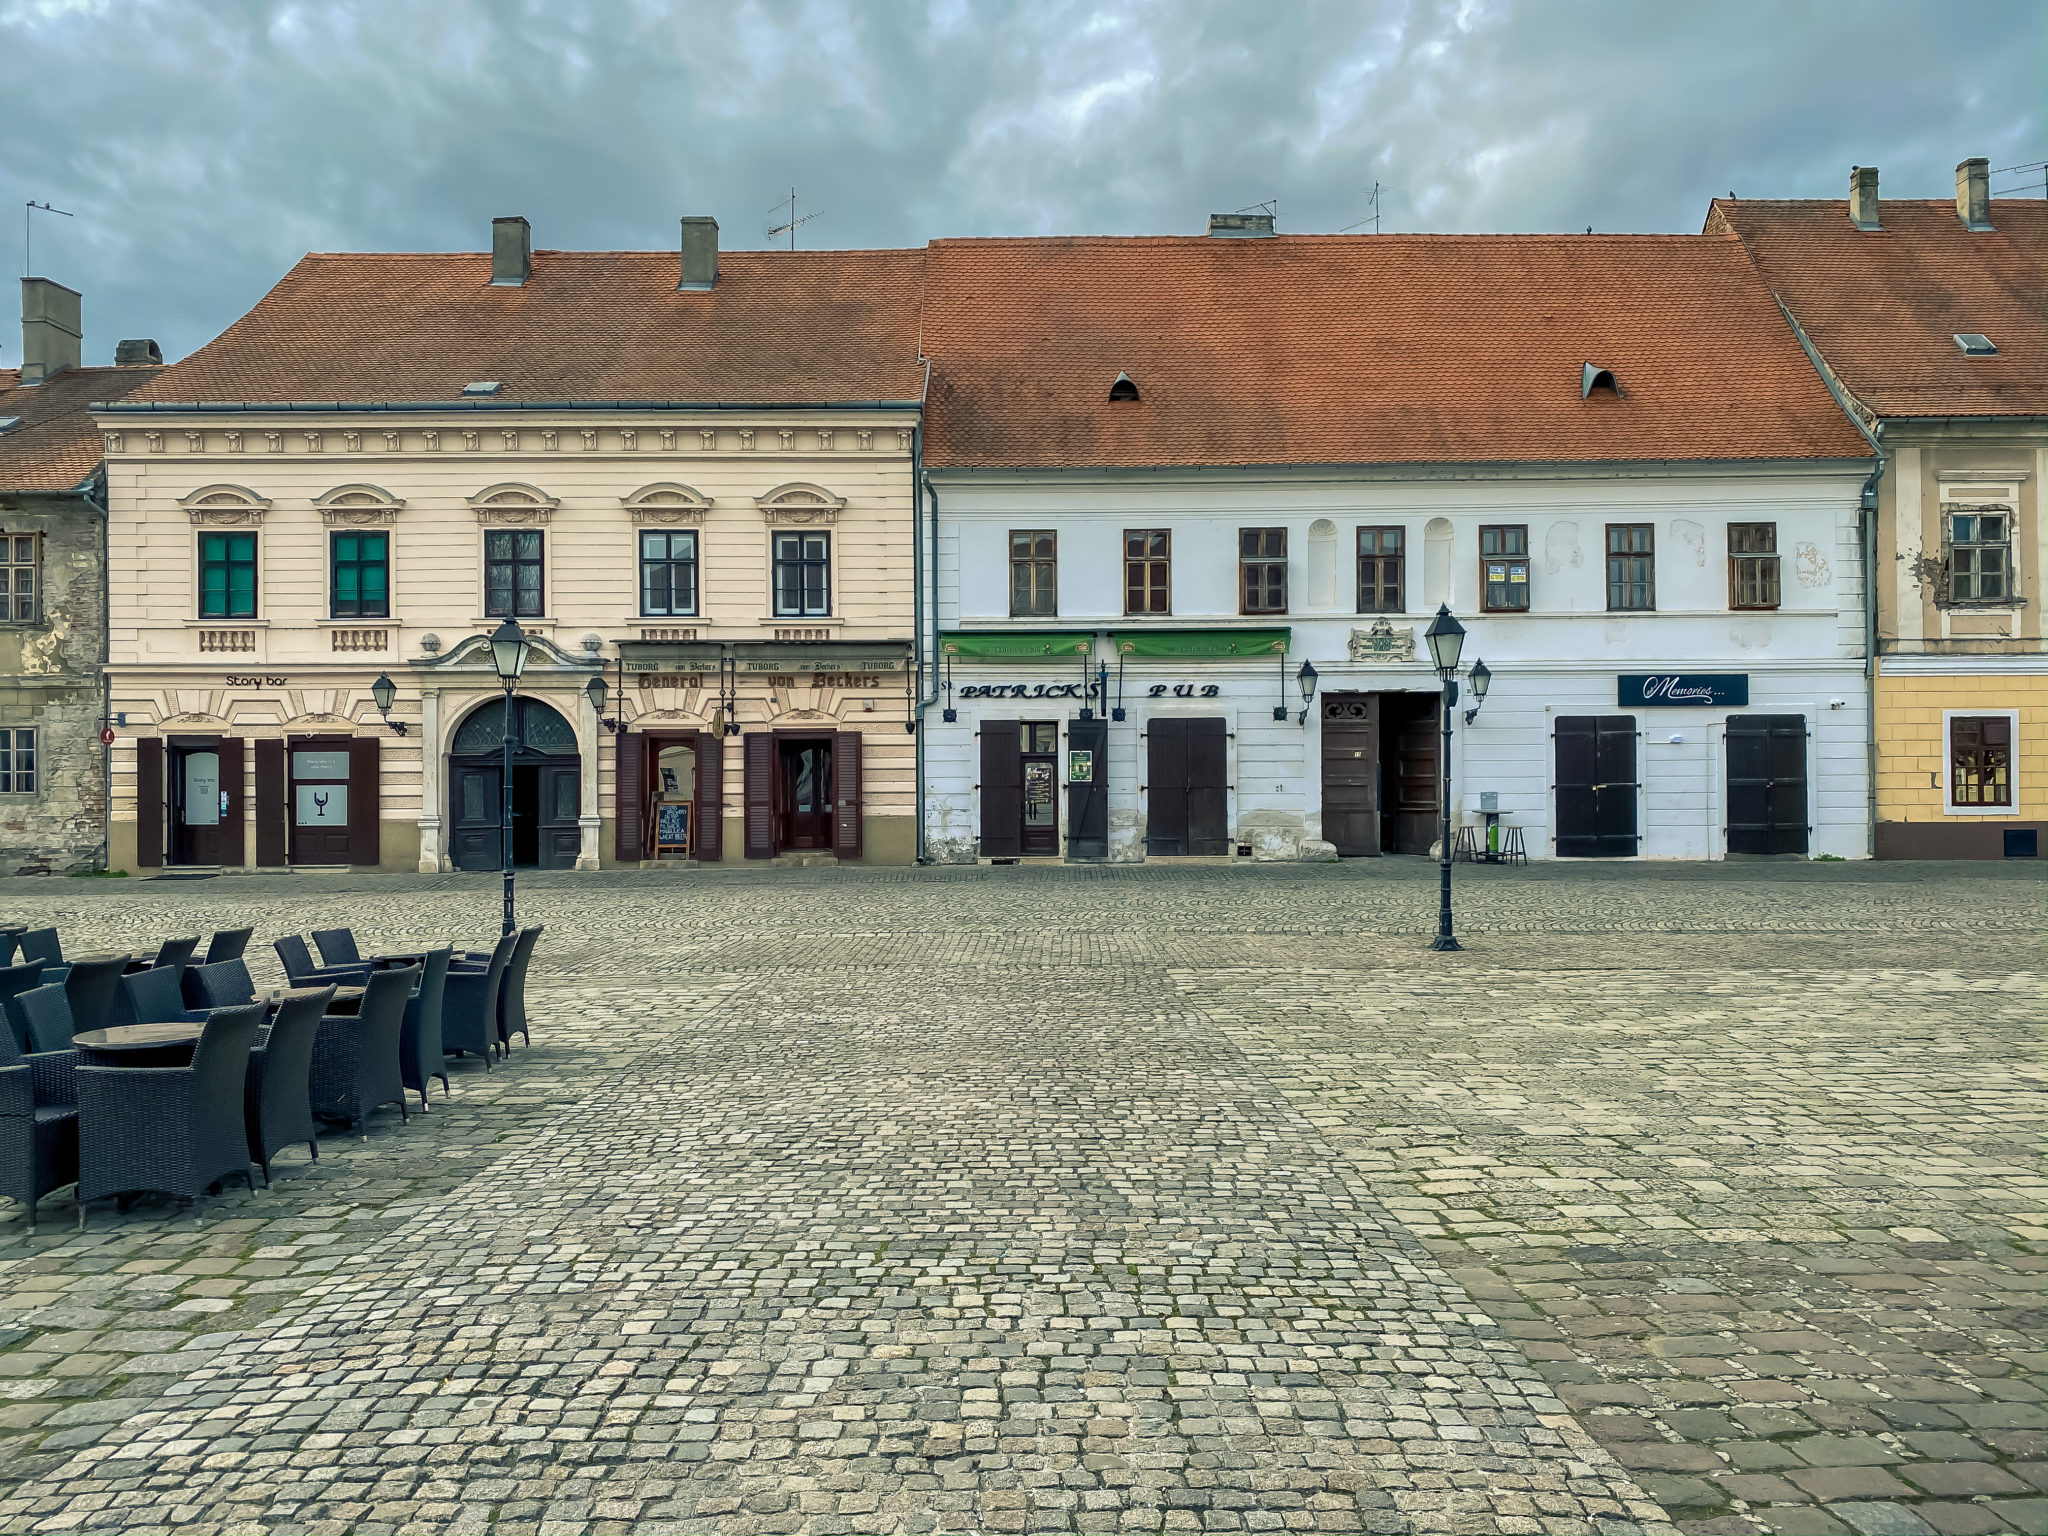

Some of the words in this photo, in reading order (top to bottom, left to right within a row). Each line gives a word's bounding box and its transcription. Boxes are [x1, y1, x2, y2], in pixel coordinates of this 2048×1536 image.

[625, 662, 659, 671] TUBORG
[746, 662, 780, 671] TUBORG
[861, 661, 895, 670] TUBORG
[226, 675, 262, 690] Story
[266, 675, 288, 686] bar
[638, 672, 704, 689] General
[768, 675, 795, 688] von
[812, 672, 880, 689] Beckers
[1148, 683, 1220, 698] PUB
